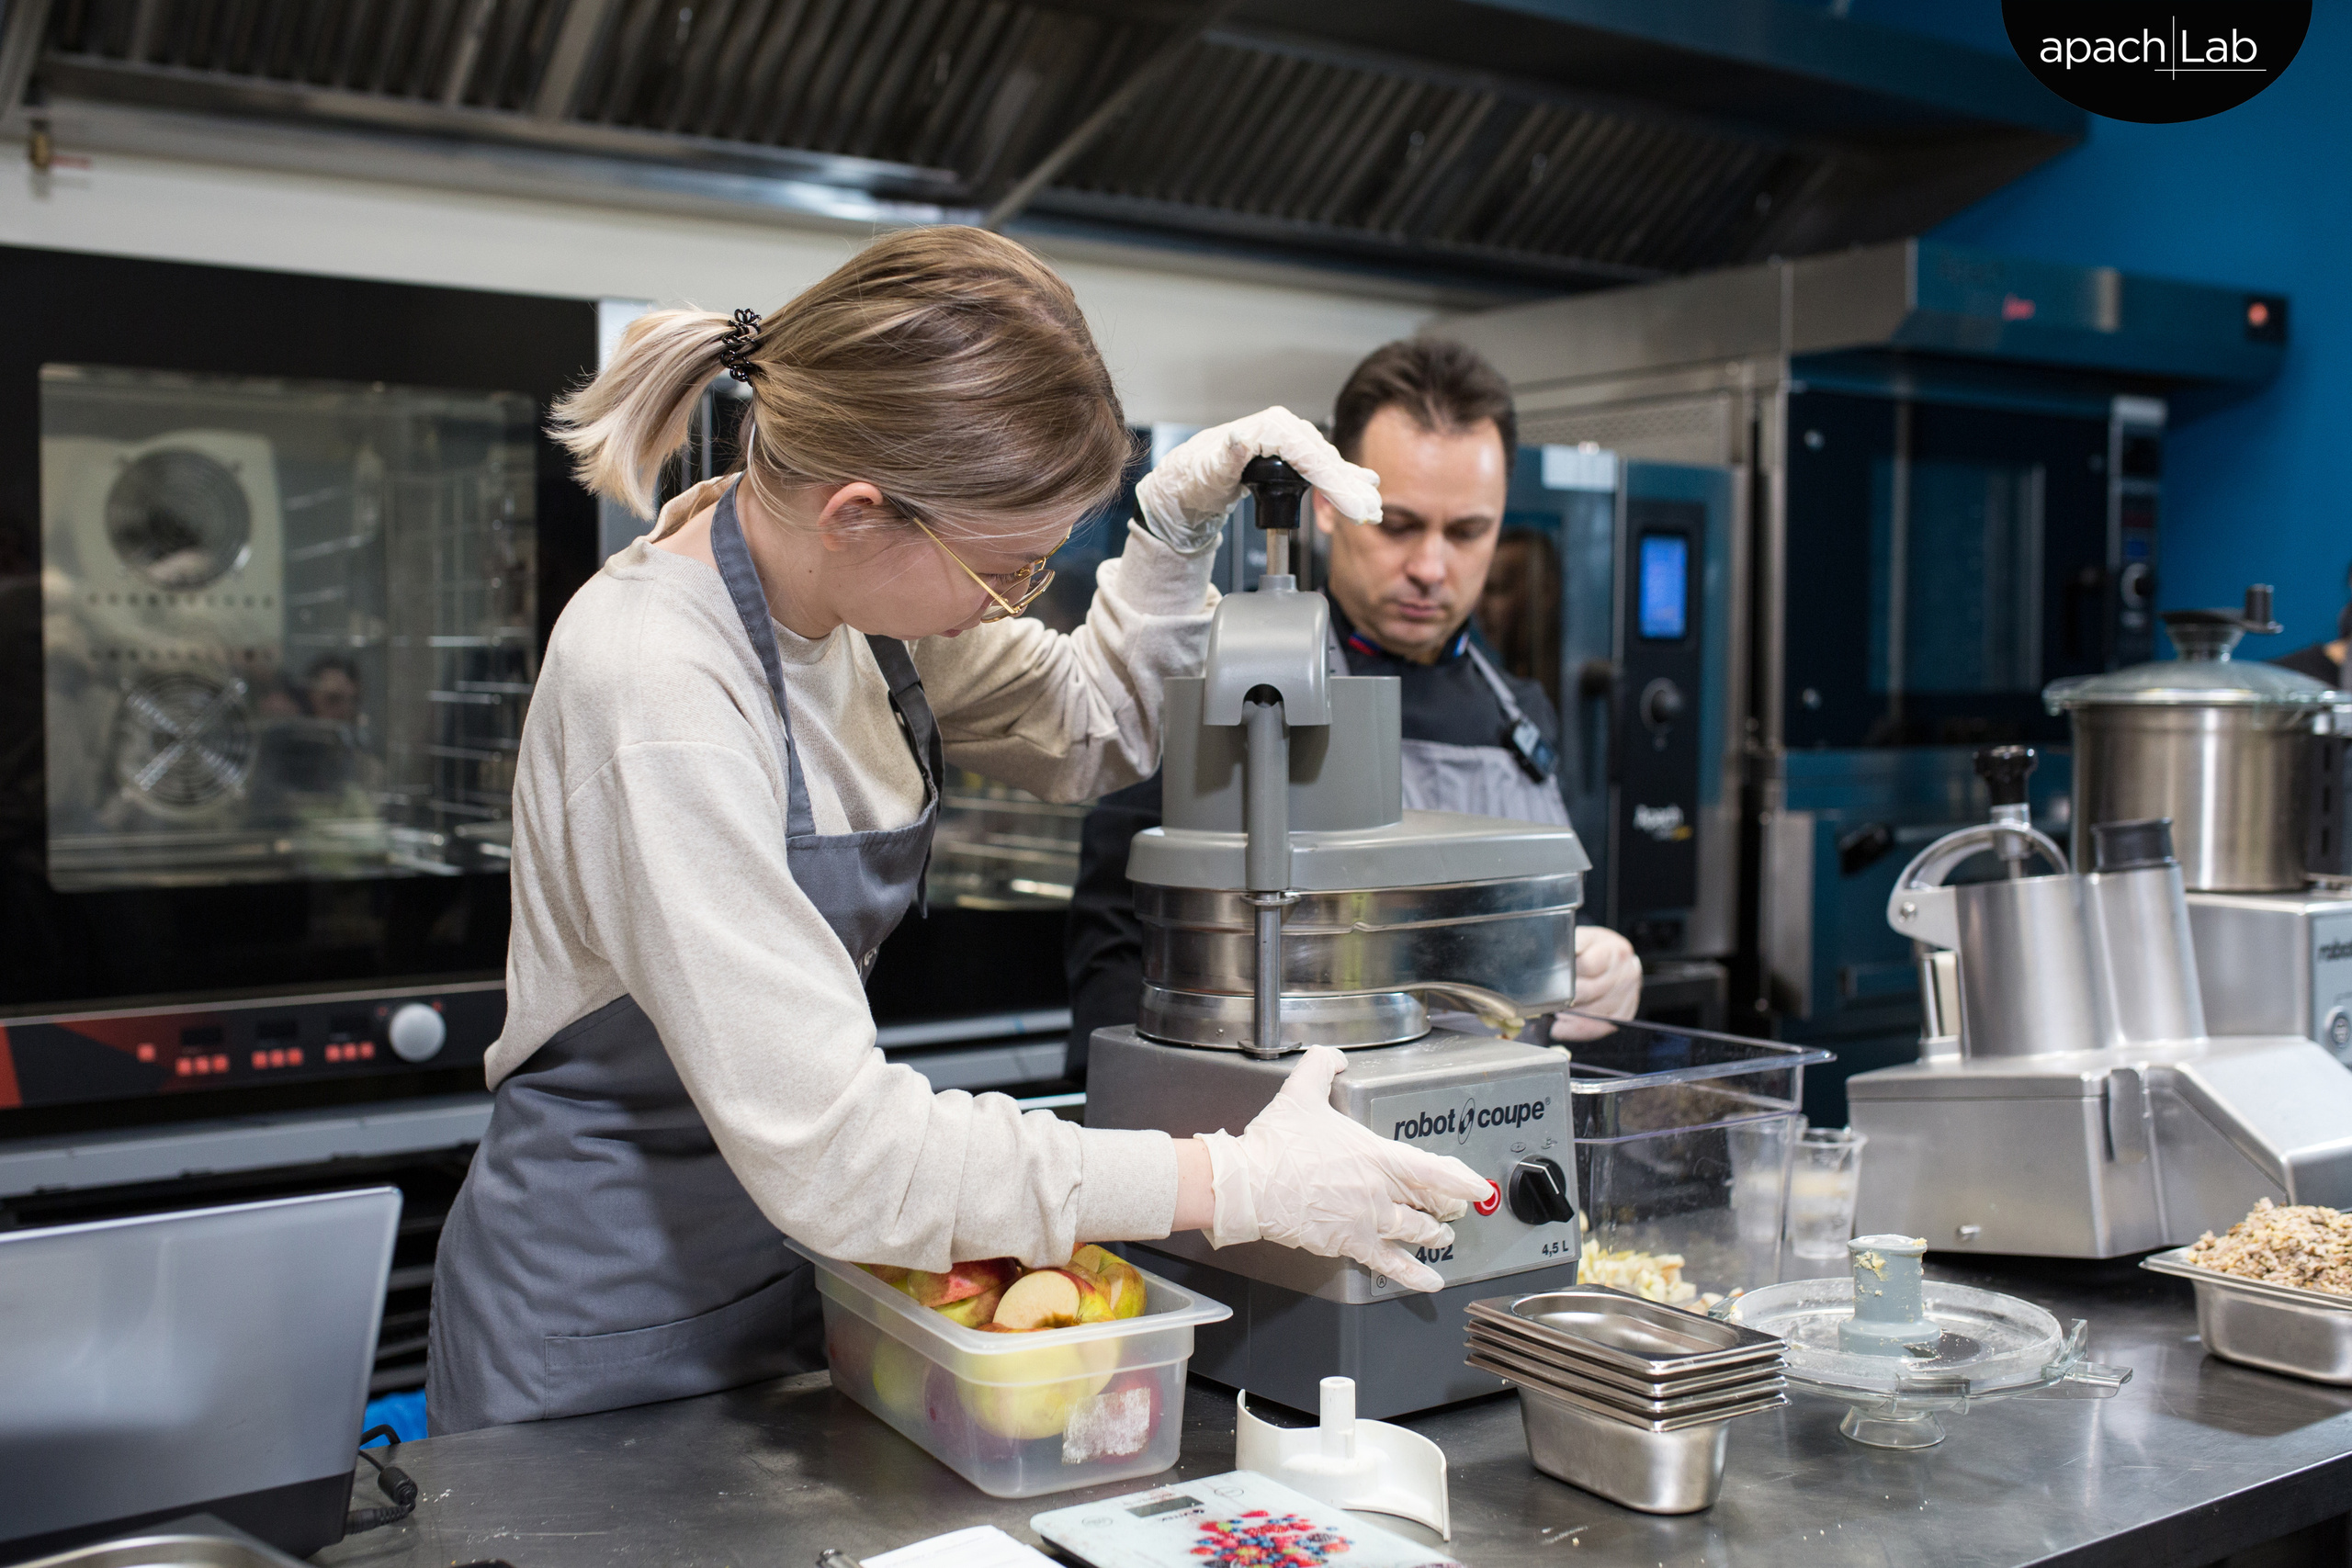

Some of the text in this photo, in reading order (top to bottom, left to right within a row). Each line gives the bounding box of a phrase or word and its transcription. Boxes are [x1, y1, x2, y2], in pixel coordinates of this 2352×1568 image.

[2319, 936, 2352, 962] robo
[1394, 1108, 1456, 1141] robot
[1542, 1240, 1569, 1258] 4,5 L
